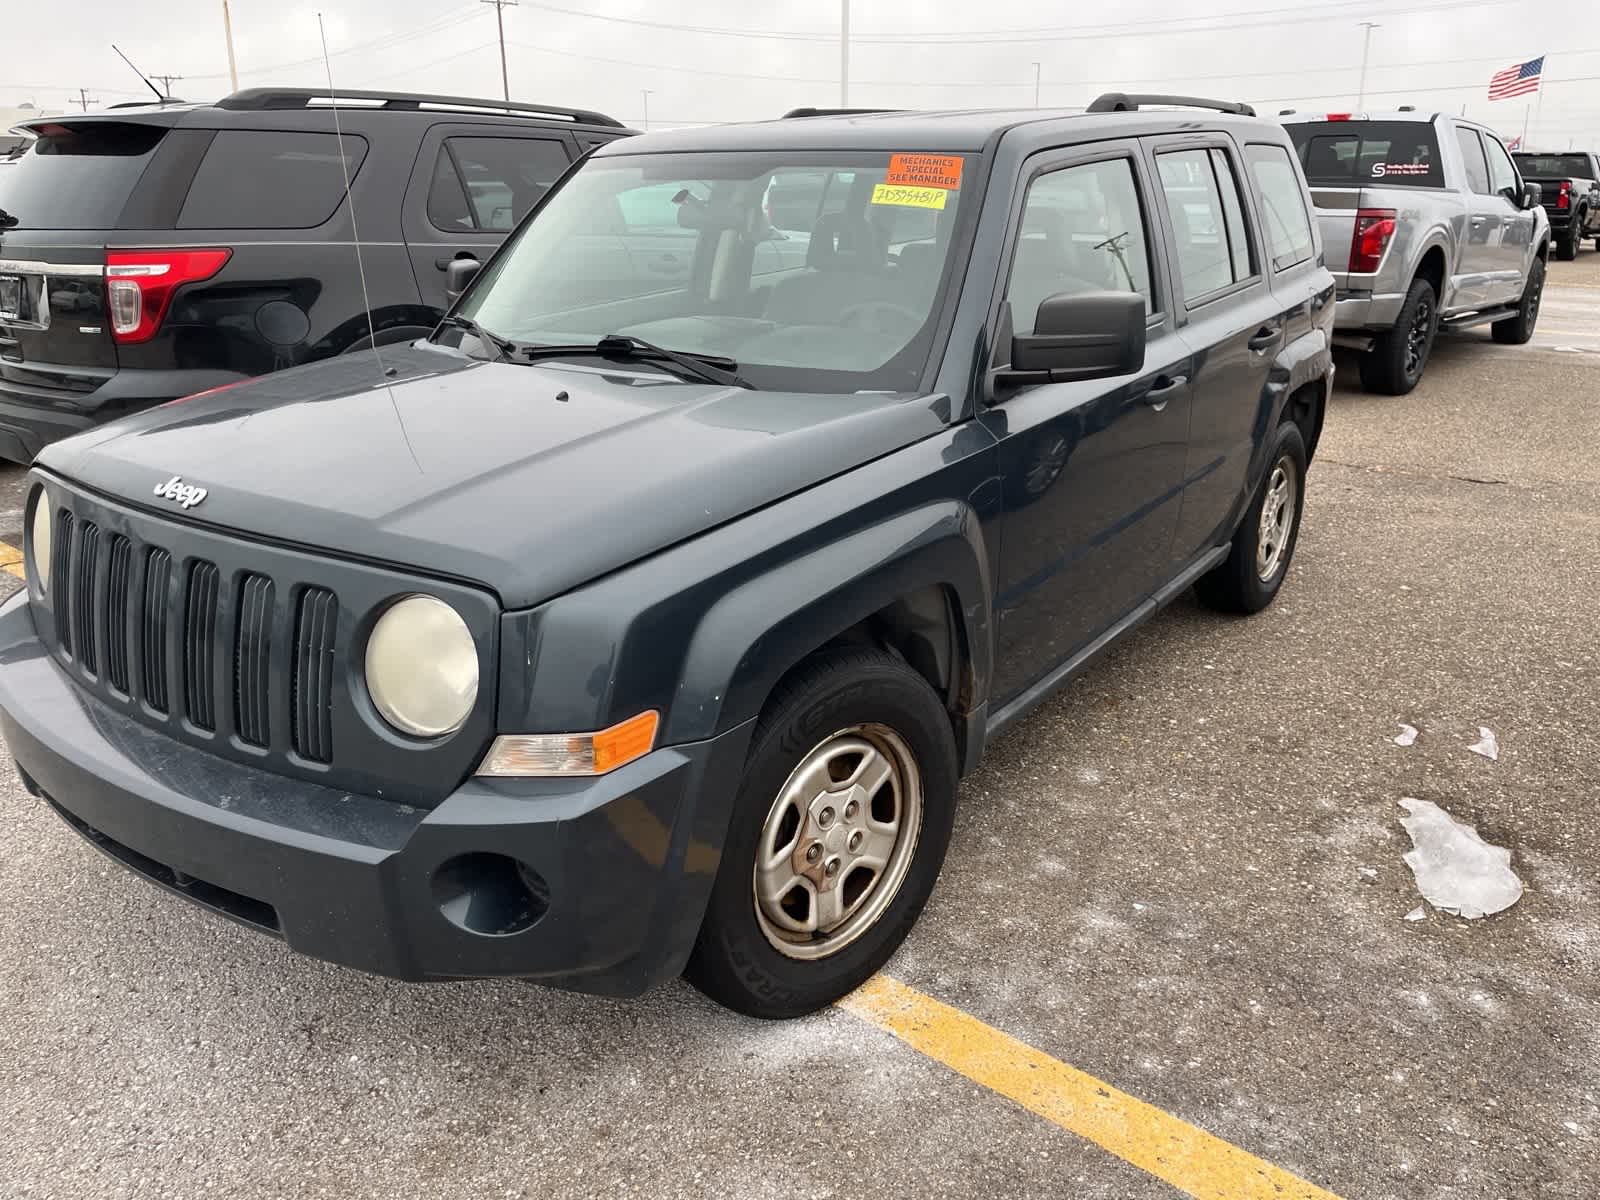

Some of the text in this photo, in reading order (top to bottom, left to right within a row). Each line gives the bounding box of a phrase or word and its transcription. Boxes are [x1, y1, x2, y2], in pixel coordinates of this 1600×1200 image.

[900, 157, 953, 167] MECHANICS
[906, 165, 944, 175] SPECIAL
[889, 173, 957, 185] SEE MANAGER
[153, 475, 208, 509] Jeep
